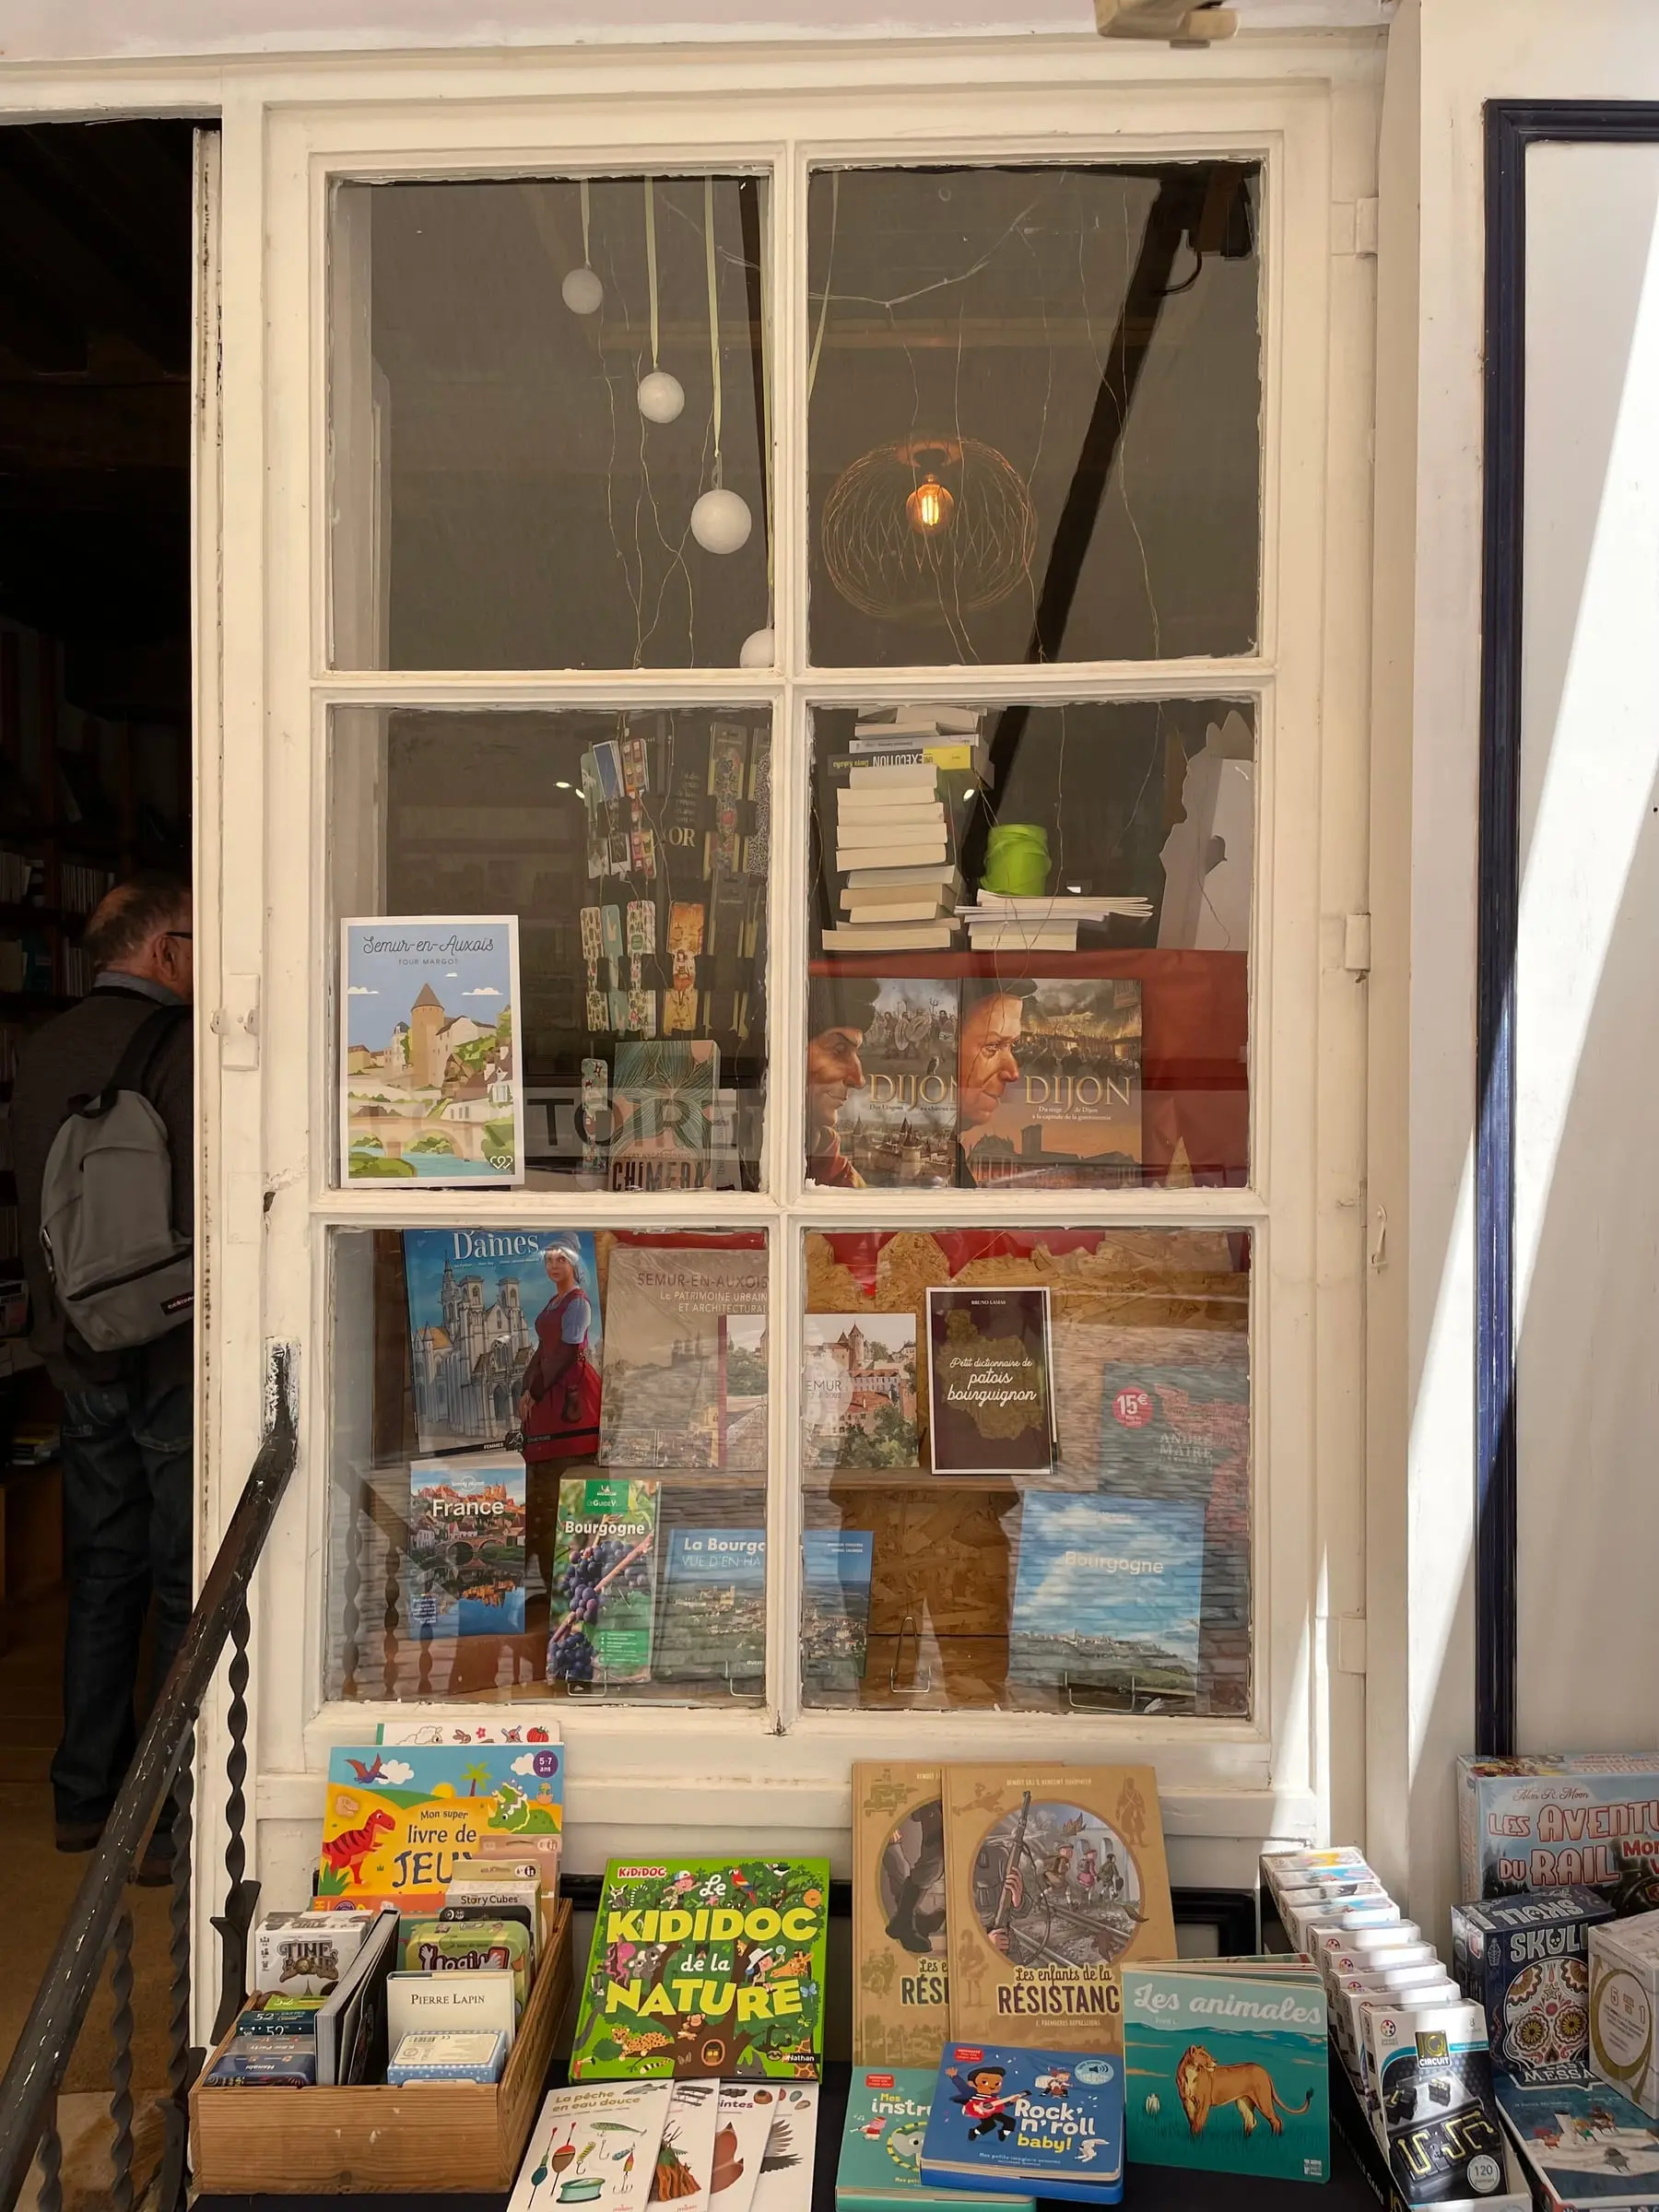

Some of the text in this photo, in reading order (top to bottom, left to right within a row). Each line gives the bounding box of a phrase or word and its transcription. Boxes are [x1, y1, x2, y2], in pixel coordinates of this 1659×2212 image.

[668, 826, 696, 848] OR
[362, 935, 495, 956] Semur-en-Auxois
[1023, 1075, 1133, 1113] DIJON
[678, 1302, 689, 1312] ET
[1021, 1356, 1033, 1367] de
[967, 1367, 1013, 1390] patois
[947, 1383, 1037, 1407] bourguignon
[432, 1499, 505, 1518] France
[565, 1521, 645, 1537] Bourgogne
[685, 1537, 702, 1550] La
[682, 1556, 705, 1567] VUE
[1065, 1551, 1164, 1575] Bourgogne
[1559, 1787, 1589, 1800] Moon
[420, 1811, 468, 1820] Mon super
[1488, 1812, 1530, 1838] LES
[407, 1823, 477, 1843] livre de
[393, 1851, 472, 1888] JEU
[1499, 1858, 1526, 1881] DU
[1530, 1845, 1620, 1886] RAIL
[461, 1895, 518, 1905] Story Cubes
[1491, 1899, 1584, 1926] SKULL
[606, 1908, 818, 1943] KIDIDOC
[276, 1939, 333, 1959] TIME
[680, 1956, 731, 1972] de la
[919, 1959, 937, 1973] Les
[1016, 1964, 1112, 1985] Les enfants de la
[411, 1994, 486, 2005] PIERRE LAPIN
[606, 1978, 803, 2022] NATURE
[997, 1983, 1123, 2014] RÉSISTANC
[1134, 1983, 1322, 2025] Les animales
[1419, 2057, 1450, 2066] CIRCUIT
[555, 2091, 615, 2104] La pêche
[571, 2101, 597, 2111] eau
[599, 2097, 641, 2107] douce
[718, 2100, 754, 2109] intes
[1015, 2099, 1083, 2122] Rock'
[1051, 2118, 1096, 2136] roll
[1017, 2132, 1072, 2153] baby!
[1475, 2165, 1493, 2176] 120
